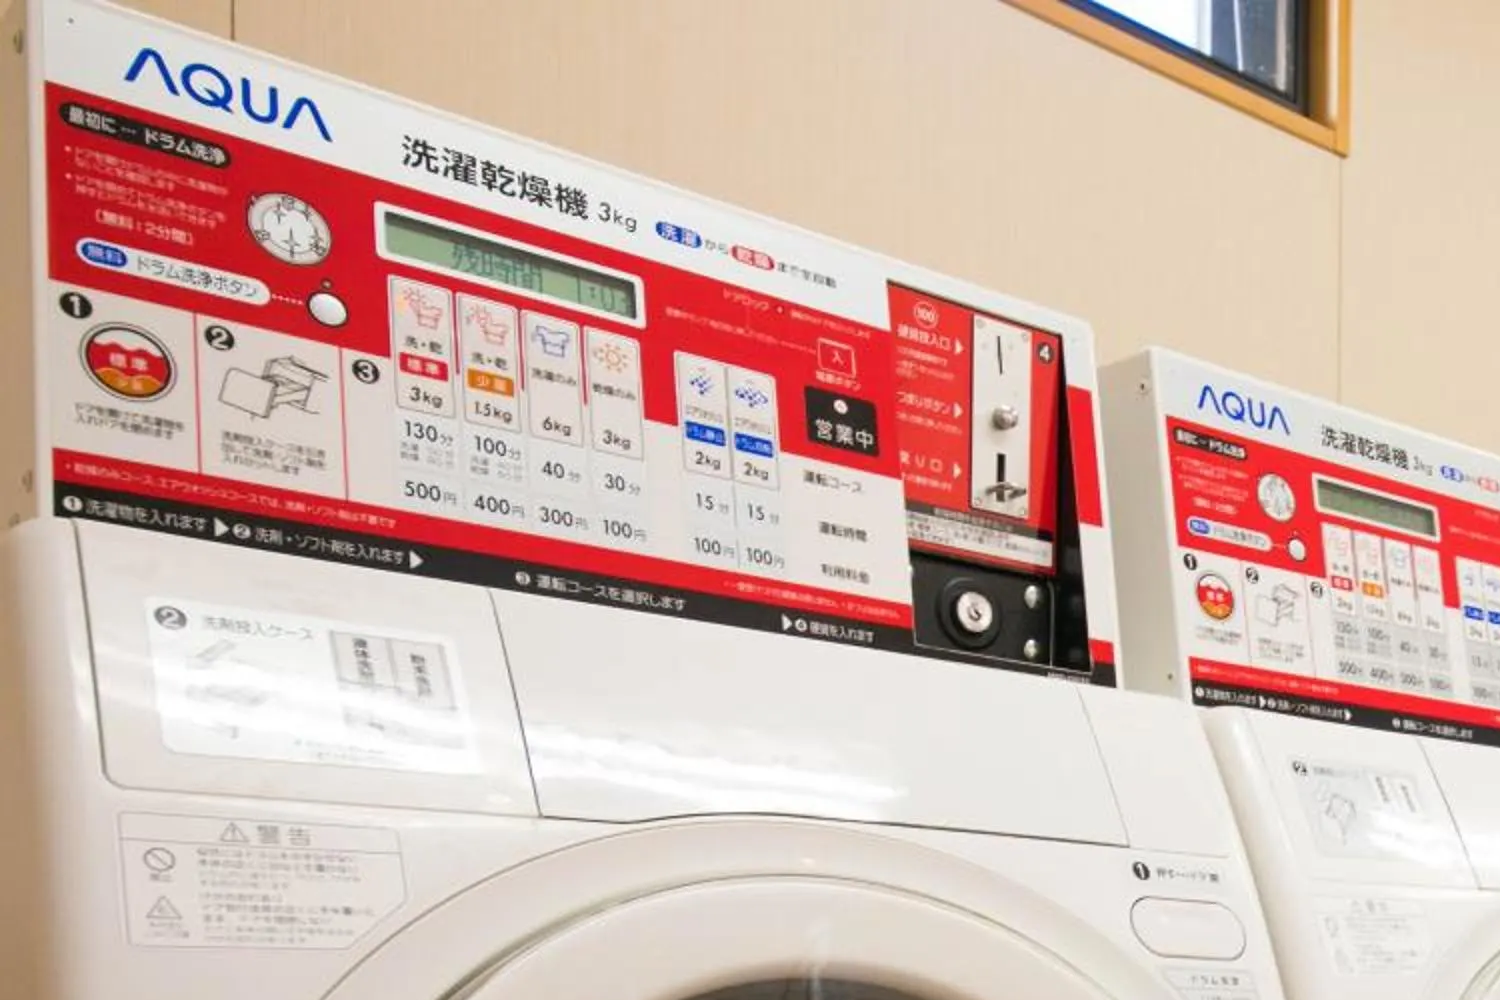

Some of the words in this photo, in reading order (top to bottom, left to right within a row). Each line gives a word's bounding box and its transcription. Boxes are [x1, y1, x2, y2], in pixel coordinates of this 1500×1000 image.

[124, 47, 333, 142] AQUA
[402, 135, 589, 221] 洗濯乾燥機
[597, 201, 638, 233] 3kg
[409, 387, 443, 409] 3kg
[1198, 383, 1290, 436] AQUA
[474, 401, 513, 423] 1.5kg
[543, 417, 572, 437] 6kg
[602, 430, 631, 450] 3kg
[815, 418, 875, 449] 営業中
[695, 452, 722, 471] 2kg
[744, 462, 769, 481] 2kg
[86, 499, 206, 531] 洗濯物を入れます
[536, 572, 686, 611] 運転コースを選択します
